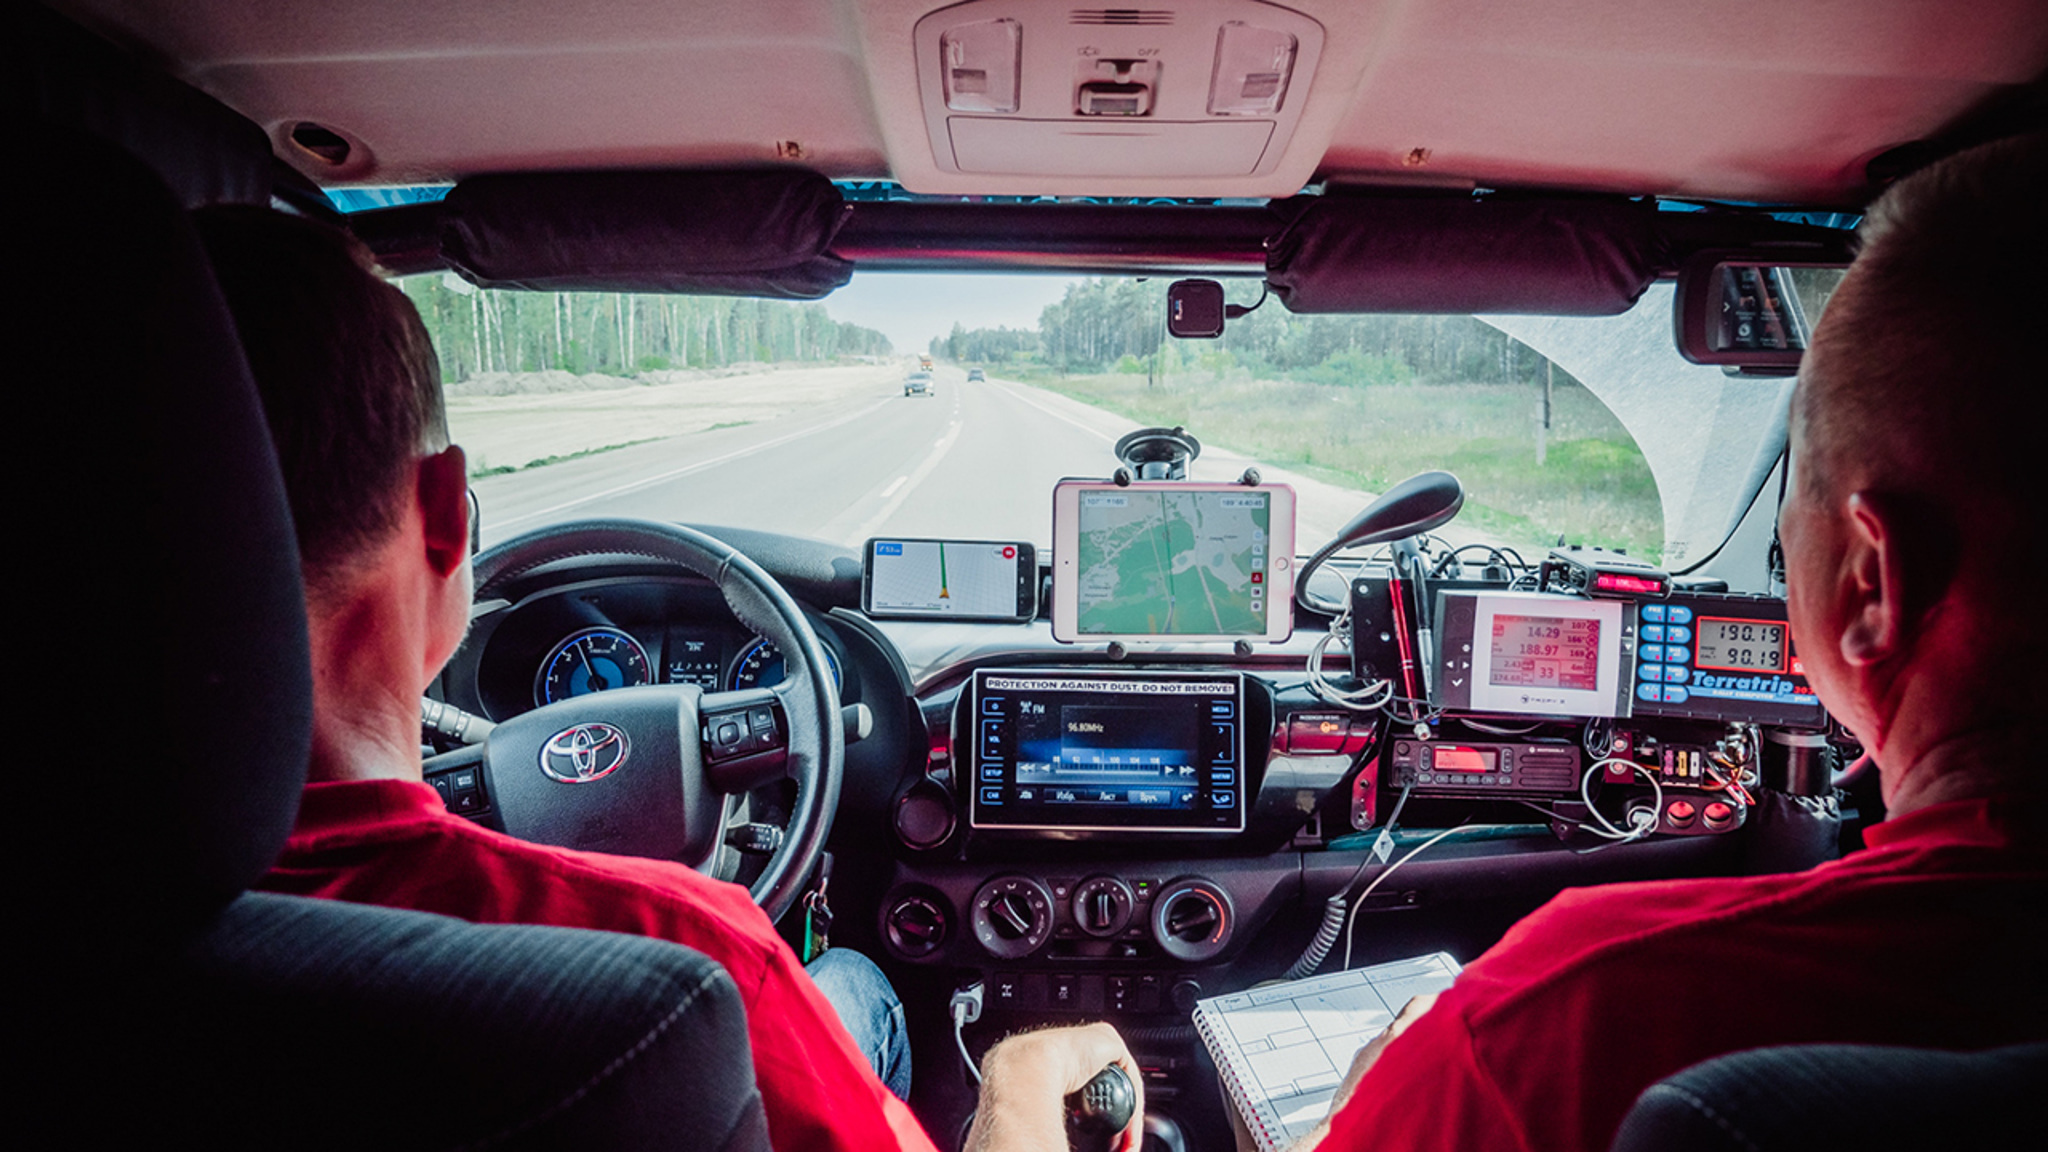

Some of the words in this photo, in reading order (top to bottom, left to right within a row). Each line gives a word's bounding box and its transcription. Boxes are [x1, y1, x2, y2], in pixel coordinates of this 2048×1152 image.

[1137, 48, 1161, 56] OFF
[1528, 626, 1560, 639] 14.29
[1720, 624, 1780, 643] 190.19
[587, 641, 594, 649] 3
[610, 643, 617, 651] 4
[1520, 643, 1559, 656] 188.97
[565, 653, 572, 662] 2
[628, 657, 635, 666] 5
[1727, 648, 1780, 667] 90.19
[1539, 667, 1554, 678] 33
[988, 679, 1057, 689] PROTECTION
[1060, 680, 1107, 690] AGAINST
[1142, 684, 1158, 692] DO
[1160, 684, 1182, 693] NOT
[1185, 684, 1232, 693] REMOVE!
[1692, 670, 1795, 697] Terratrip
[1735, 690, 1774, 699] COMPUTER
[1033, 704, 1045, 714] FM
[1224, 996, 1241, 1006] Page
